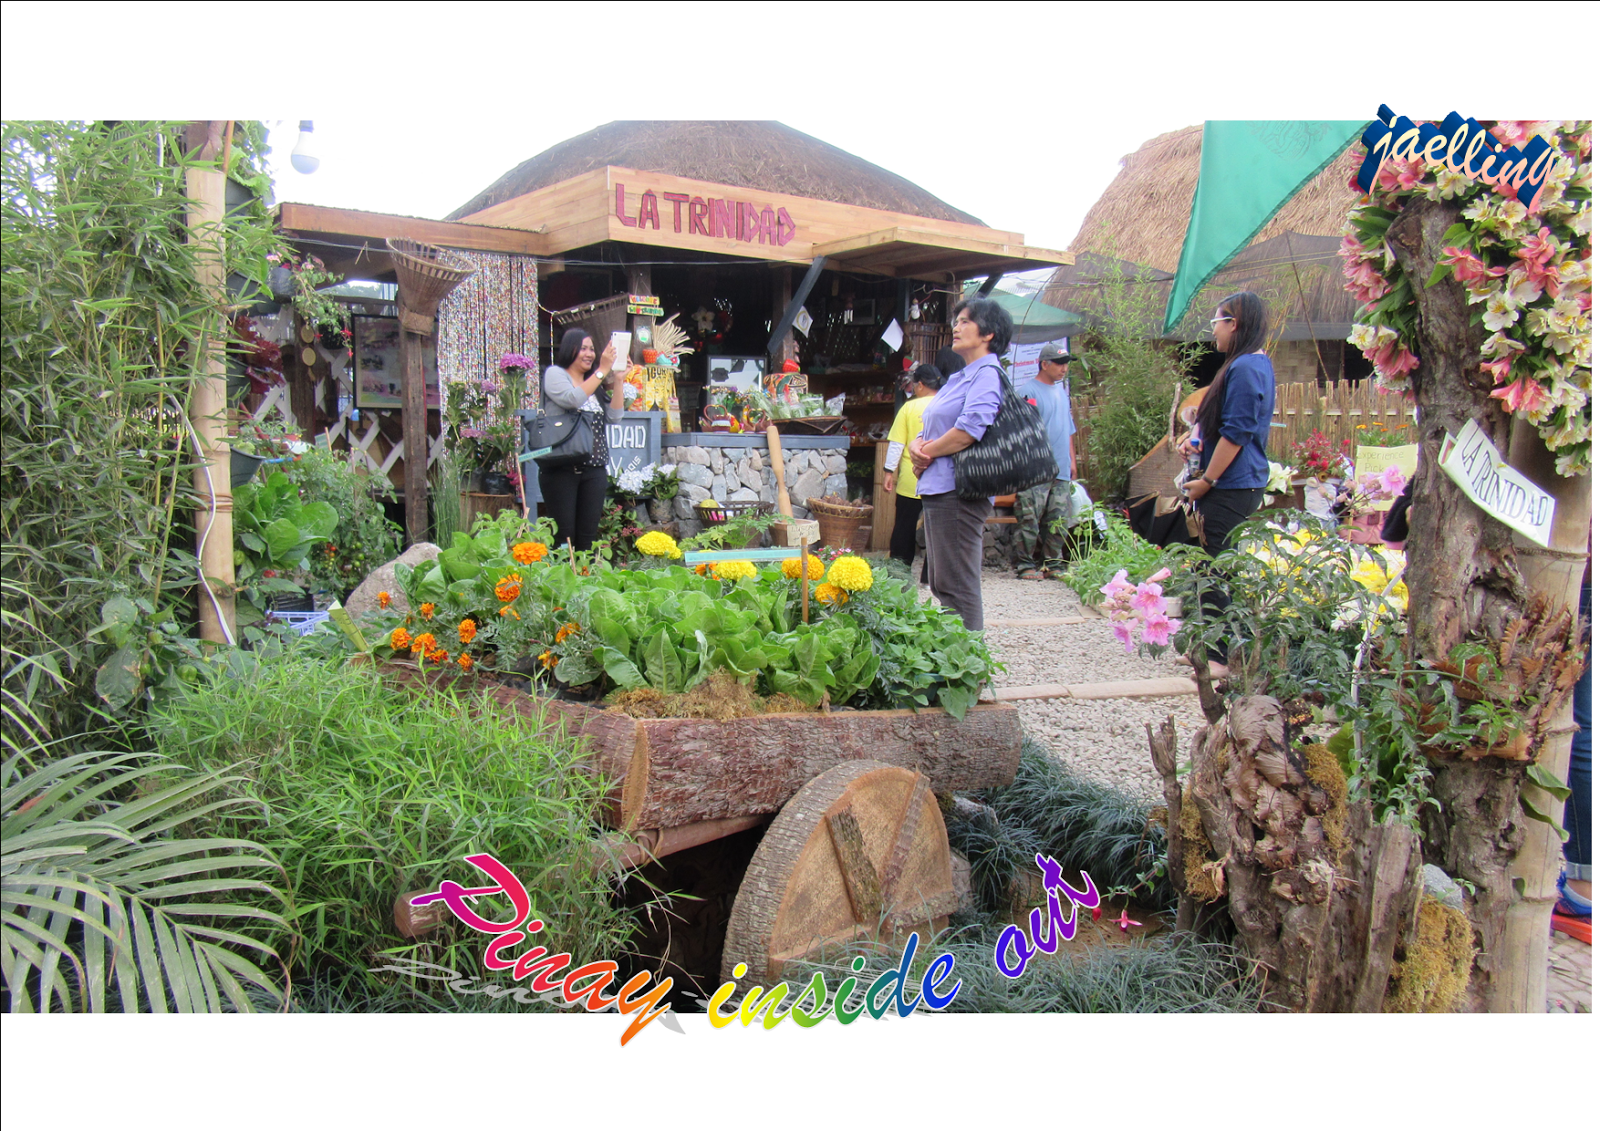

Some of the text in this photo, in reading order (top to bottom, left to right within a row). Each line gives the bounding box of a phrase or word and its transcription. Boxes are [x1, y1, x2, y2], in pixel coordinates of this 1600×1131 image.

[616, 183, 796, 247] LA TRINIDAD
[605, 424, 646, 449] IDAD
[1356, 449, 1404, 462] Experience
[1364, 463, 1384, 473] Pick
[1461, 426, 1549, 527] LA TRINIDAD
